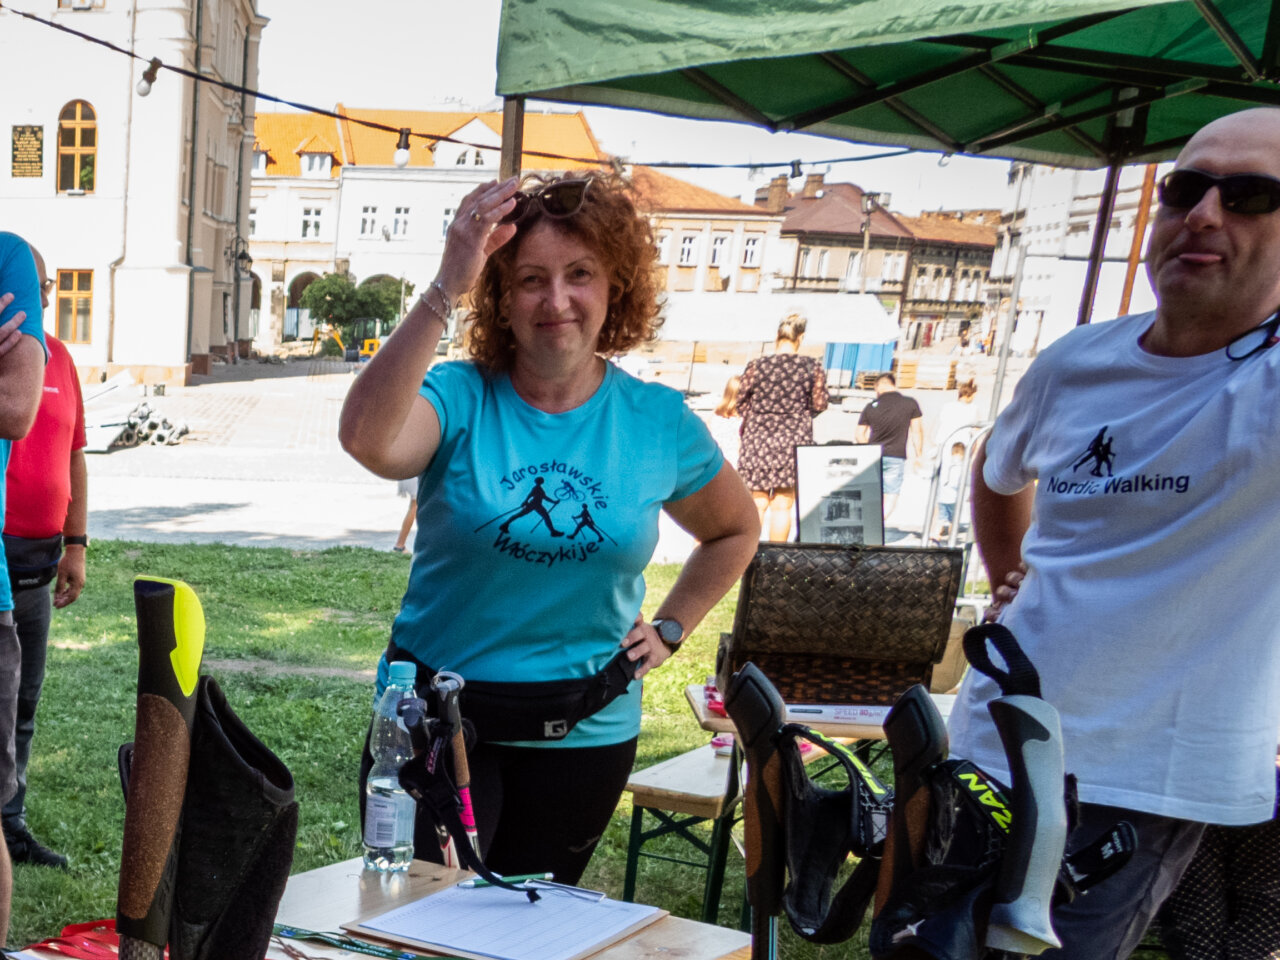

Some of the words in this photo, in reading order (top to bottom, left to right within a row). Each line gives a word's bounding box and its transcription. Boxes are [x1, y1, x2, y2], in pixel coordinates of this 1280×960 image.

[499, 459, 610, 511] Jarosławskie
[1047, 476, 1099, 495] Nordic
[1104, 474, 1190, 494] Walking
[493, 531, 601, 569] Włóczykije
[958, 773, 1013, 834] ZAN
